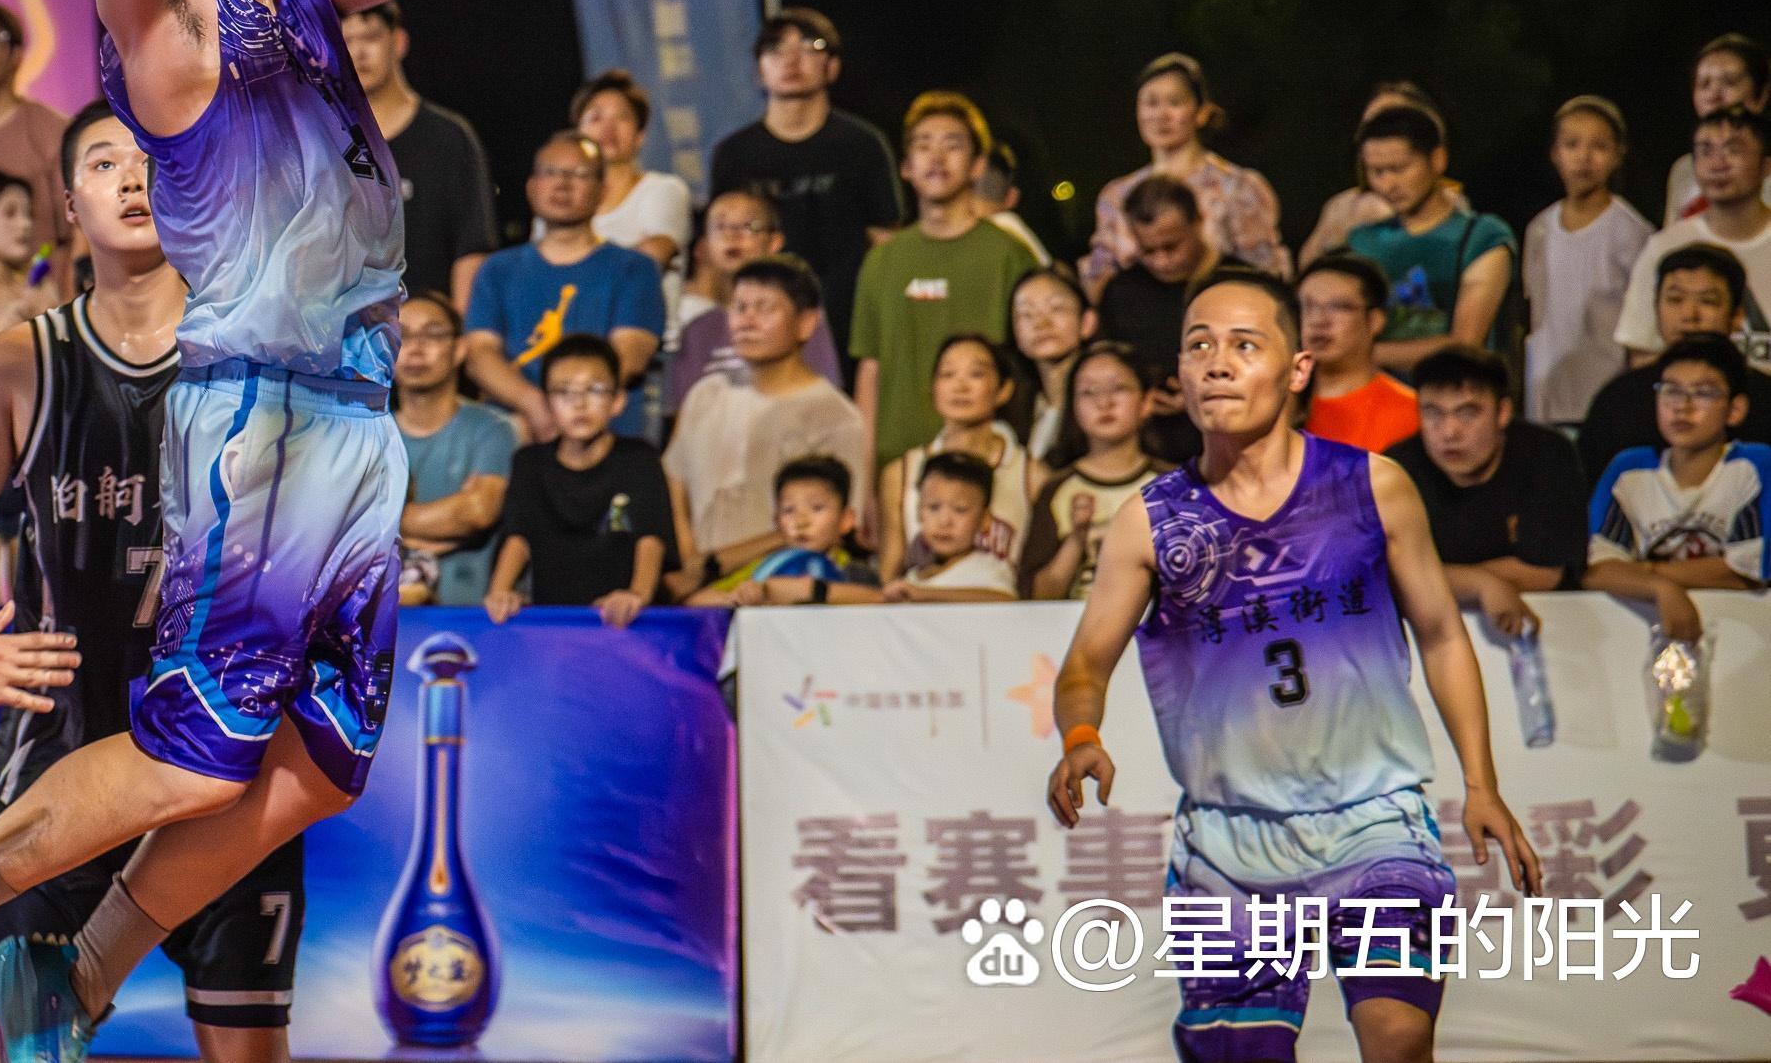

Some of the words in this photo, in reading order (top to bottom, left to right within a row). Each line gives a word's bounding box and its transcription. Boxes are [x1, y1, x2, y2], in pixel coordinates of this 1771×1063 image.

[126, 547, 166, 628] 7
[1263, 638, 1310, 708] 3
[260, 891, 292, 965] 7
